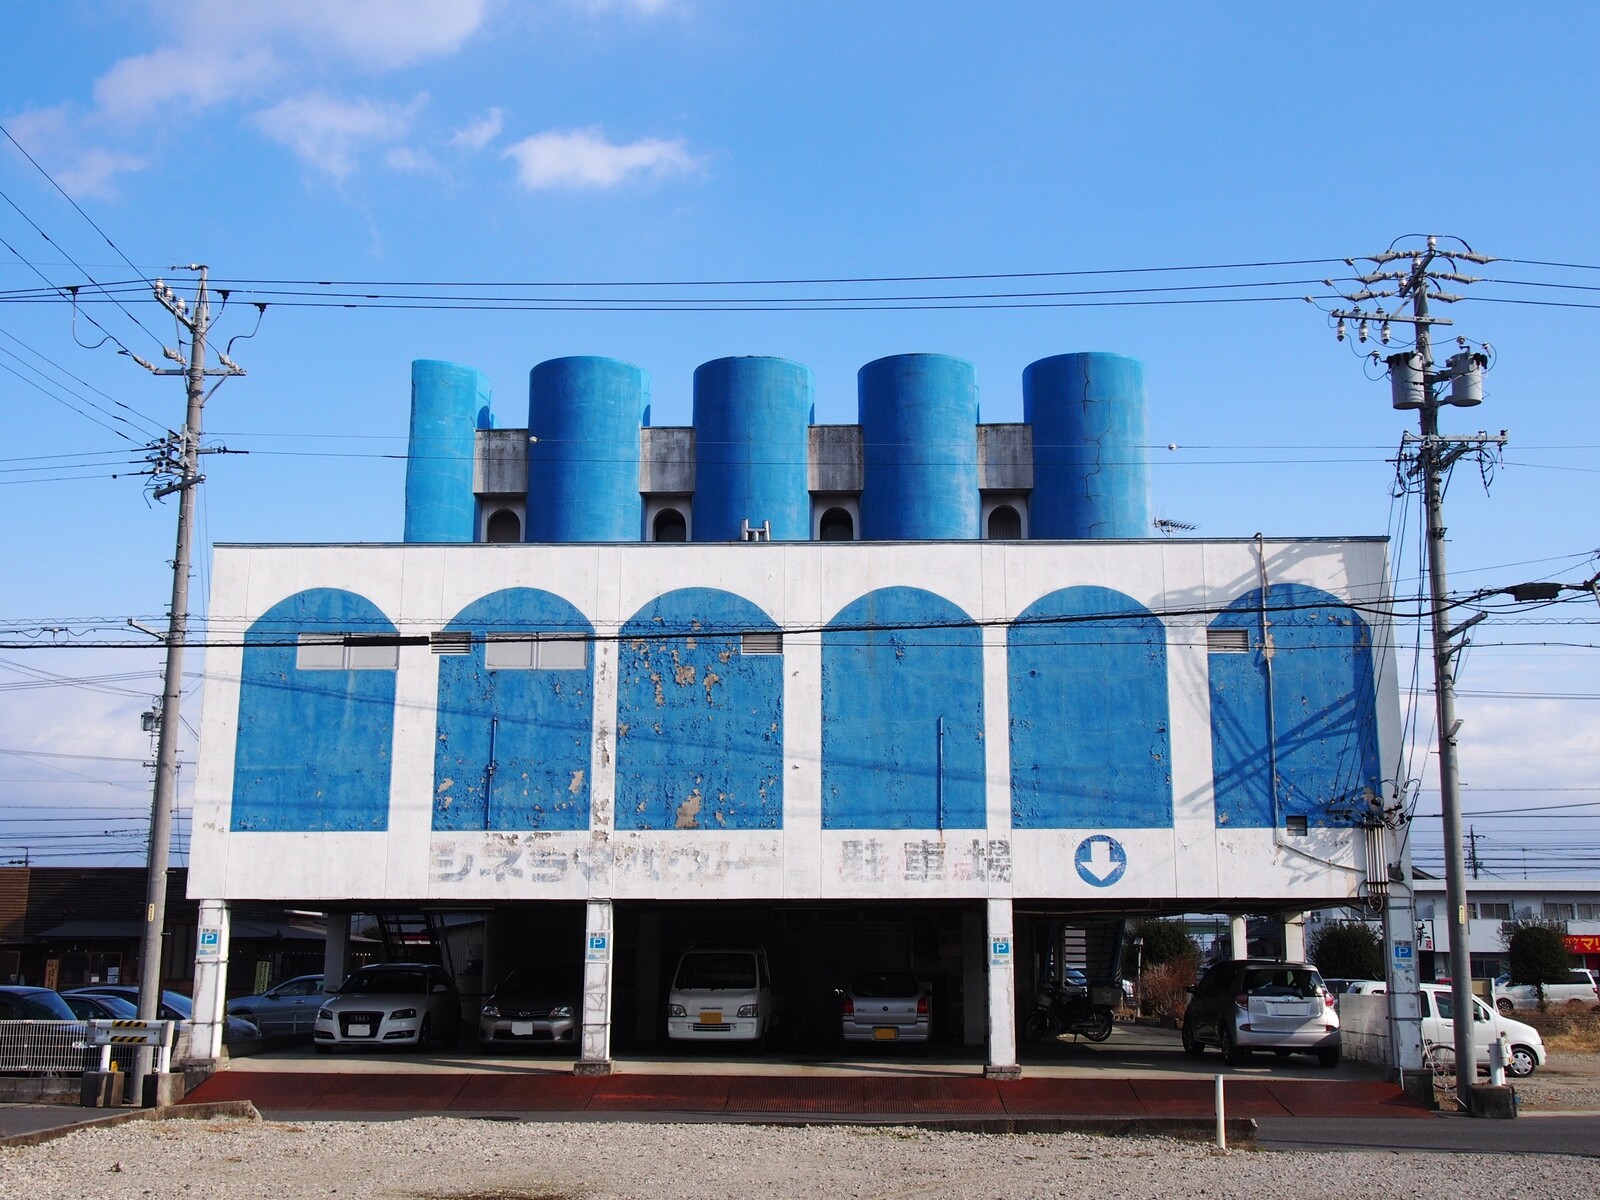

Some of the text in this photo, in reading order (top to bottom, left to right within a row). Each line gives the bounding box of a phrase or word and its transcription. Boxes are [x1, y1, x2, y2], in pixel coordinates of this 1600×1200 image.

[204, 934, 215, 944] P
[593, 938, 603, 948] P
[996, 943, 1006, 953] P
[1398, 947, 1409, 957] P
